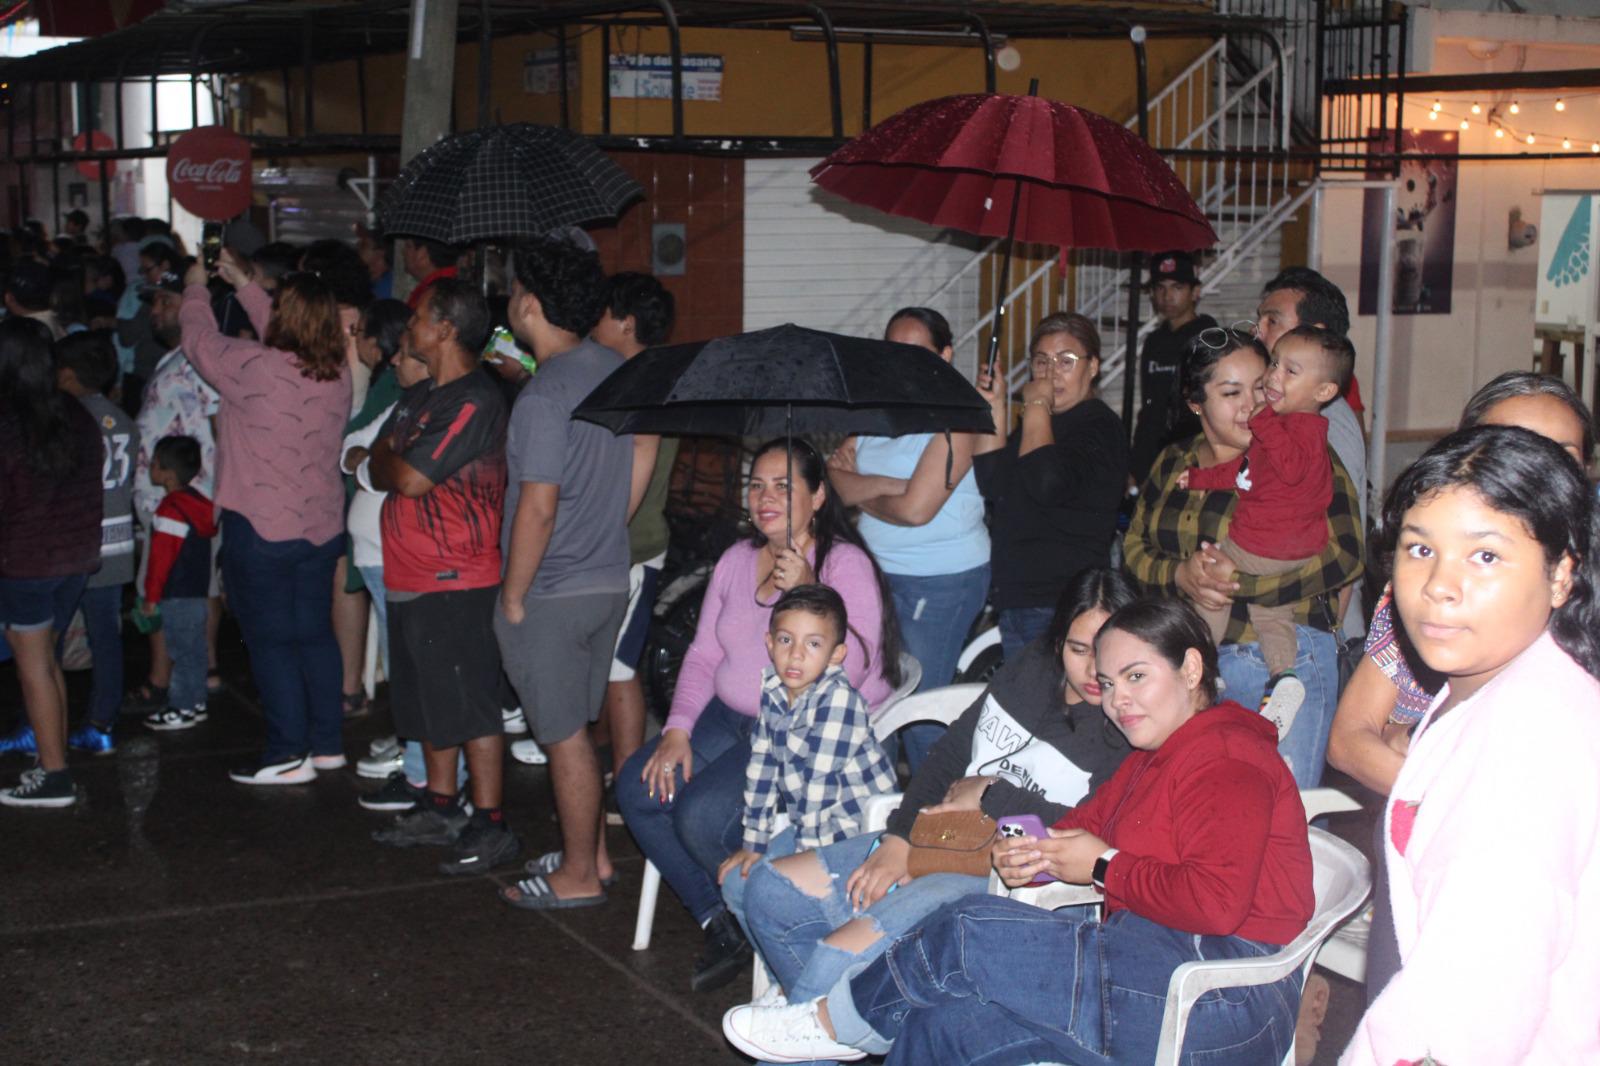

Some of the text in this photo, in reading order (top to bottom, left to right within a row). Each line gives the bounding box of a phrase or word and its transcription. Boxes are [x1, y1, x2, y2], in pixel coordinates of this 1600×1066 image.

[172, 157, 245, 183] Coca-Cola
[102, 433, 131, 489] 23
[999, 758, 1048, 797] DENIM
